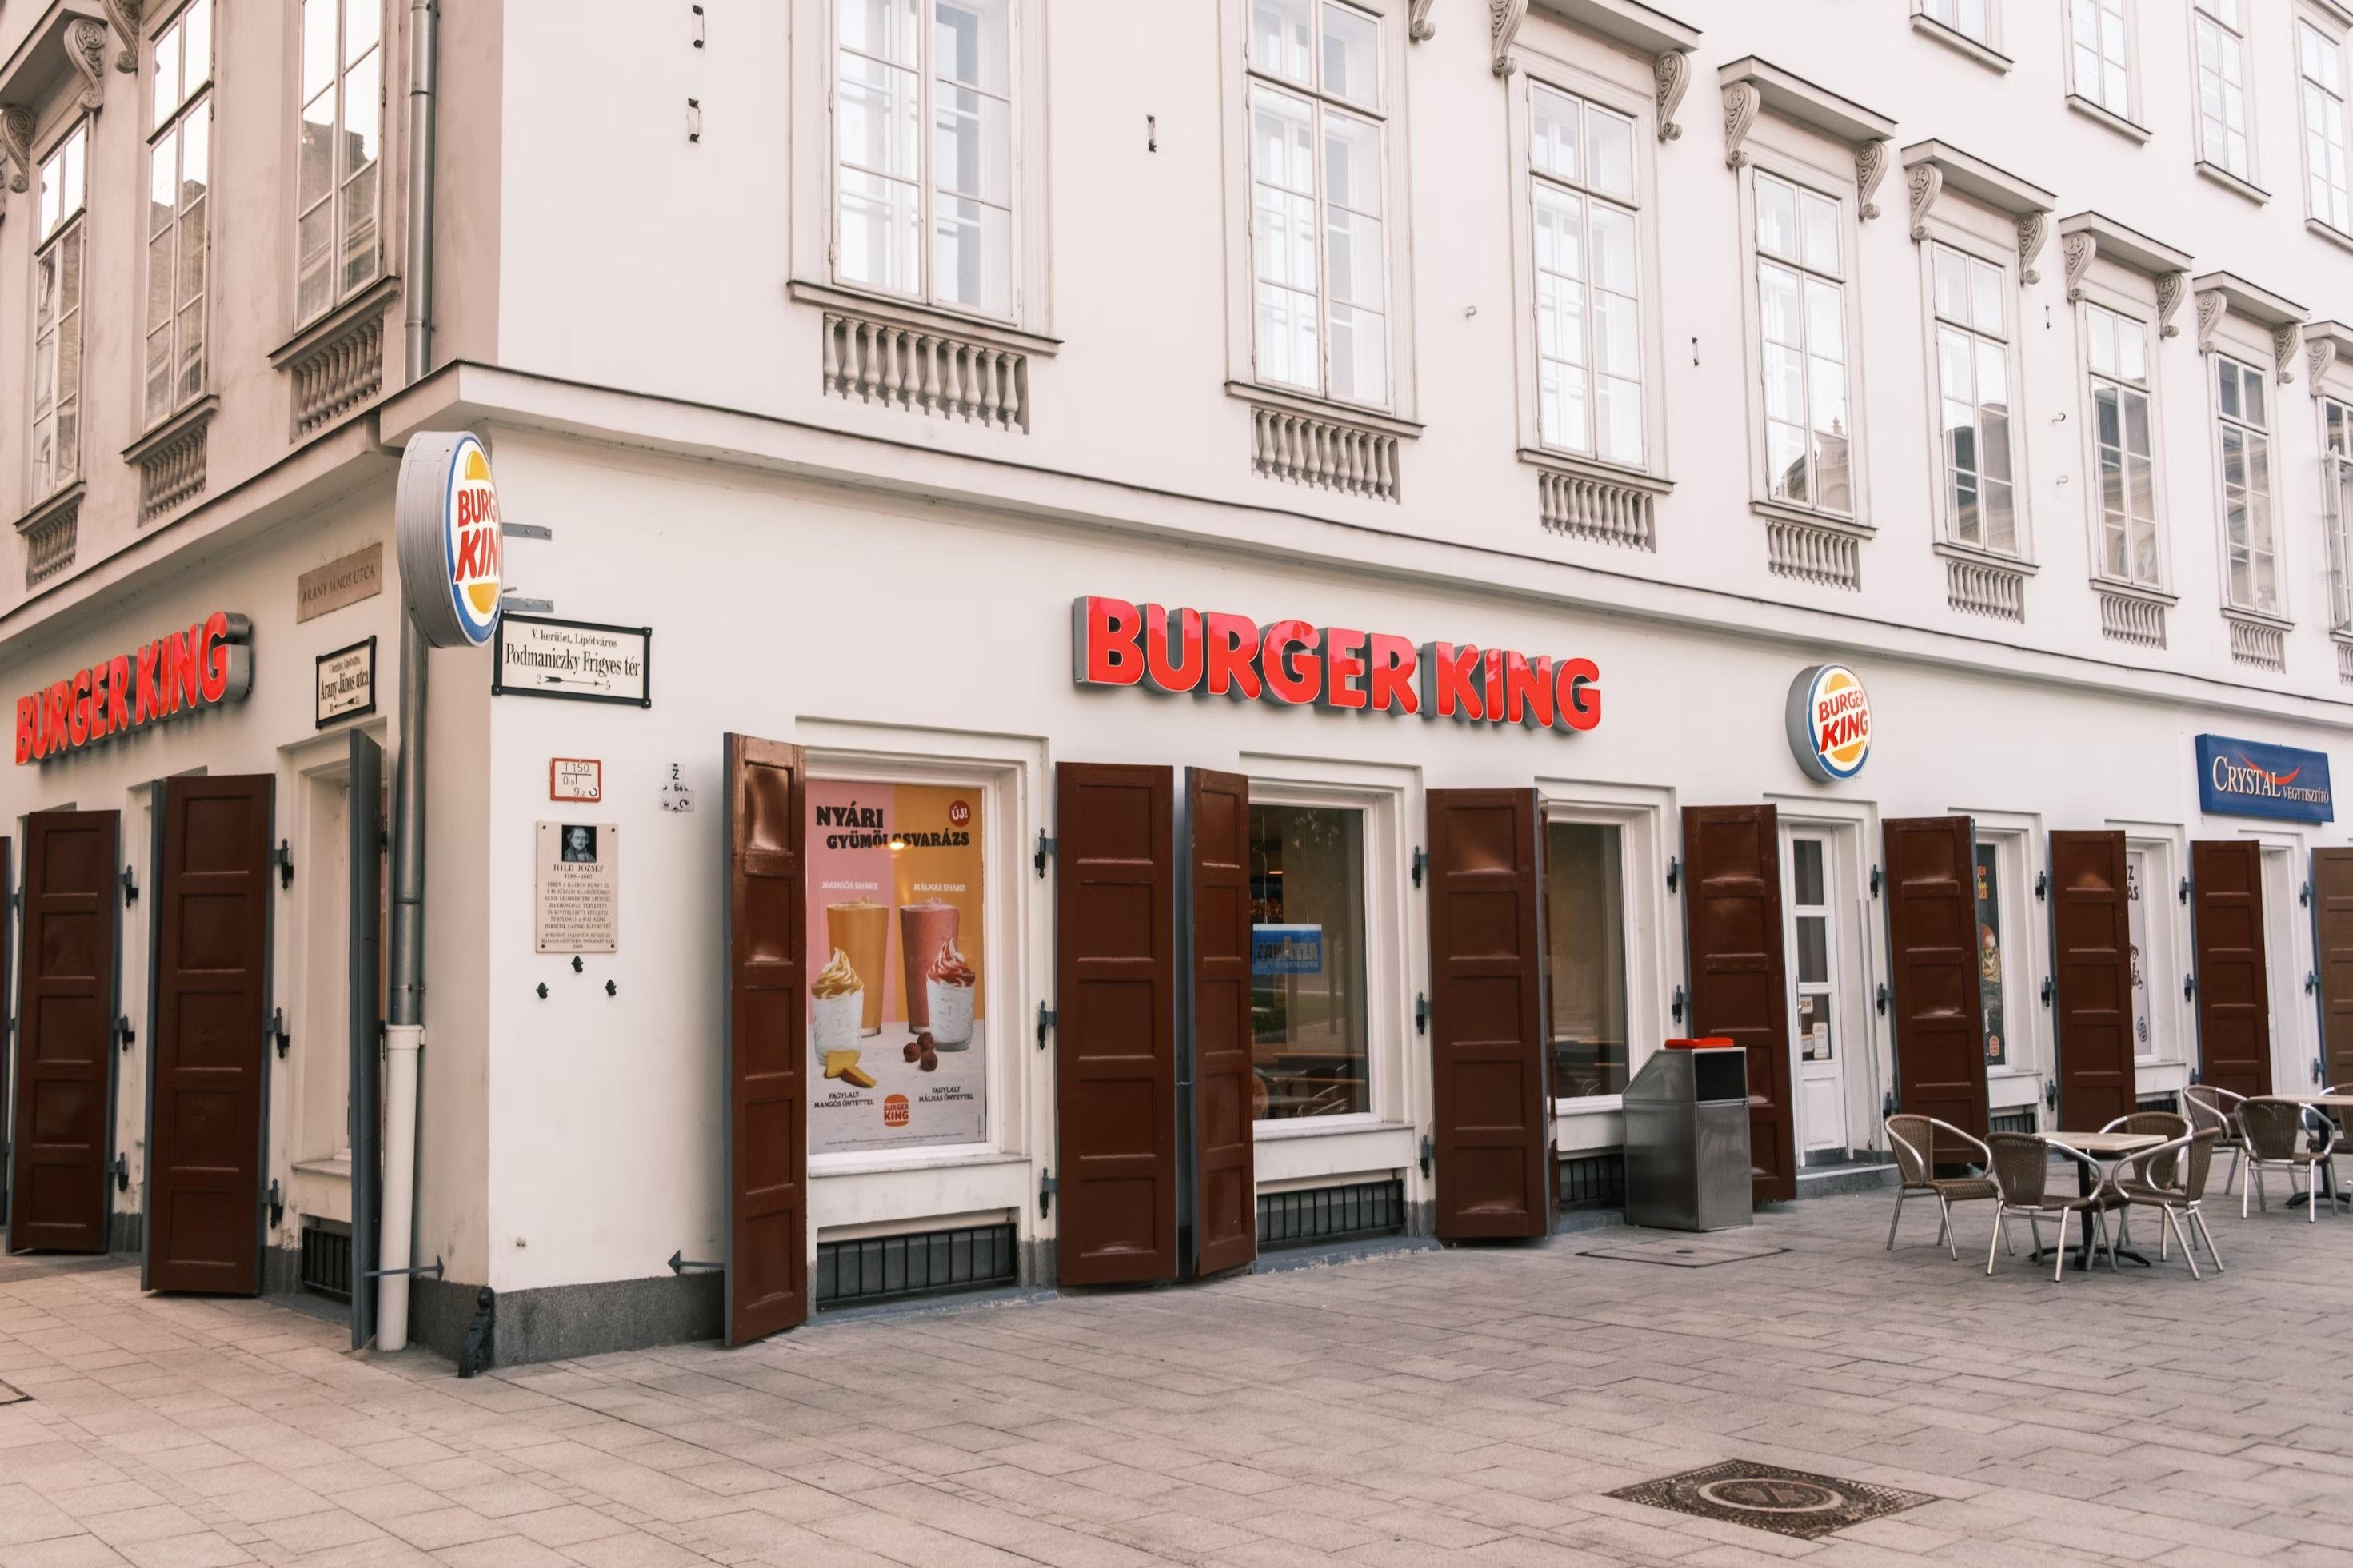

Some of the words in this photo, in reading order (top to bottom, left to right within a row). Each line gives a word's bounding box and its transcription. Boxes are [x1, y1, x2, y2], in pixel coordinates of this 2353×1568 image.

[457, 489, 498, 528] BURG
[454, 527, 500, 582] KIN
[302, 581, 328, 605] ARANY
[354, 563, 374, 585] UTCA
[531, 628, 538, 640] V.
[575, 633, 617, 648] Lipótváros
[505, 643, 581, 675] Podmaniczky
[583, 651, 622, 677] Frigyes
[625, 656, 641, 676] tér
[1085, 595, 1419, 715] BURGER
[1434, 640, 1601, 732] KING
[16, 653, 130, 765] BURGER
[135, 611, 229, 726] KING
[321, 679, 338, 700] Arany
[356, 667, 369, 688] utca
[537, 674, 542, 684] 2
[605, 680, 611, 691] 5
[1818, 689, 1865, 723] BURGER
[1820, 709, 1868, 753] KING
[572, 763, 589, 773] 150
[2212, 755, 2281, 798] CRYSTAL
[2283, 786, 2329, 804] VEGYTISZTÍTÓ
[816, 801, 884, 828] NYÁRI
[951, 807, 968, 820] ÚJ!
[913, 883, 943, 892] MÁLNÁS
[884, 1111, 909, 1121] KING
